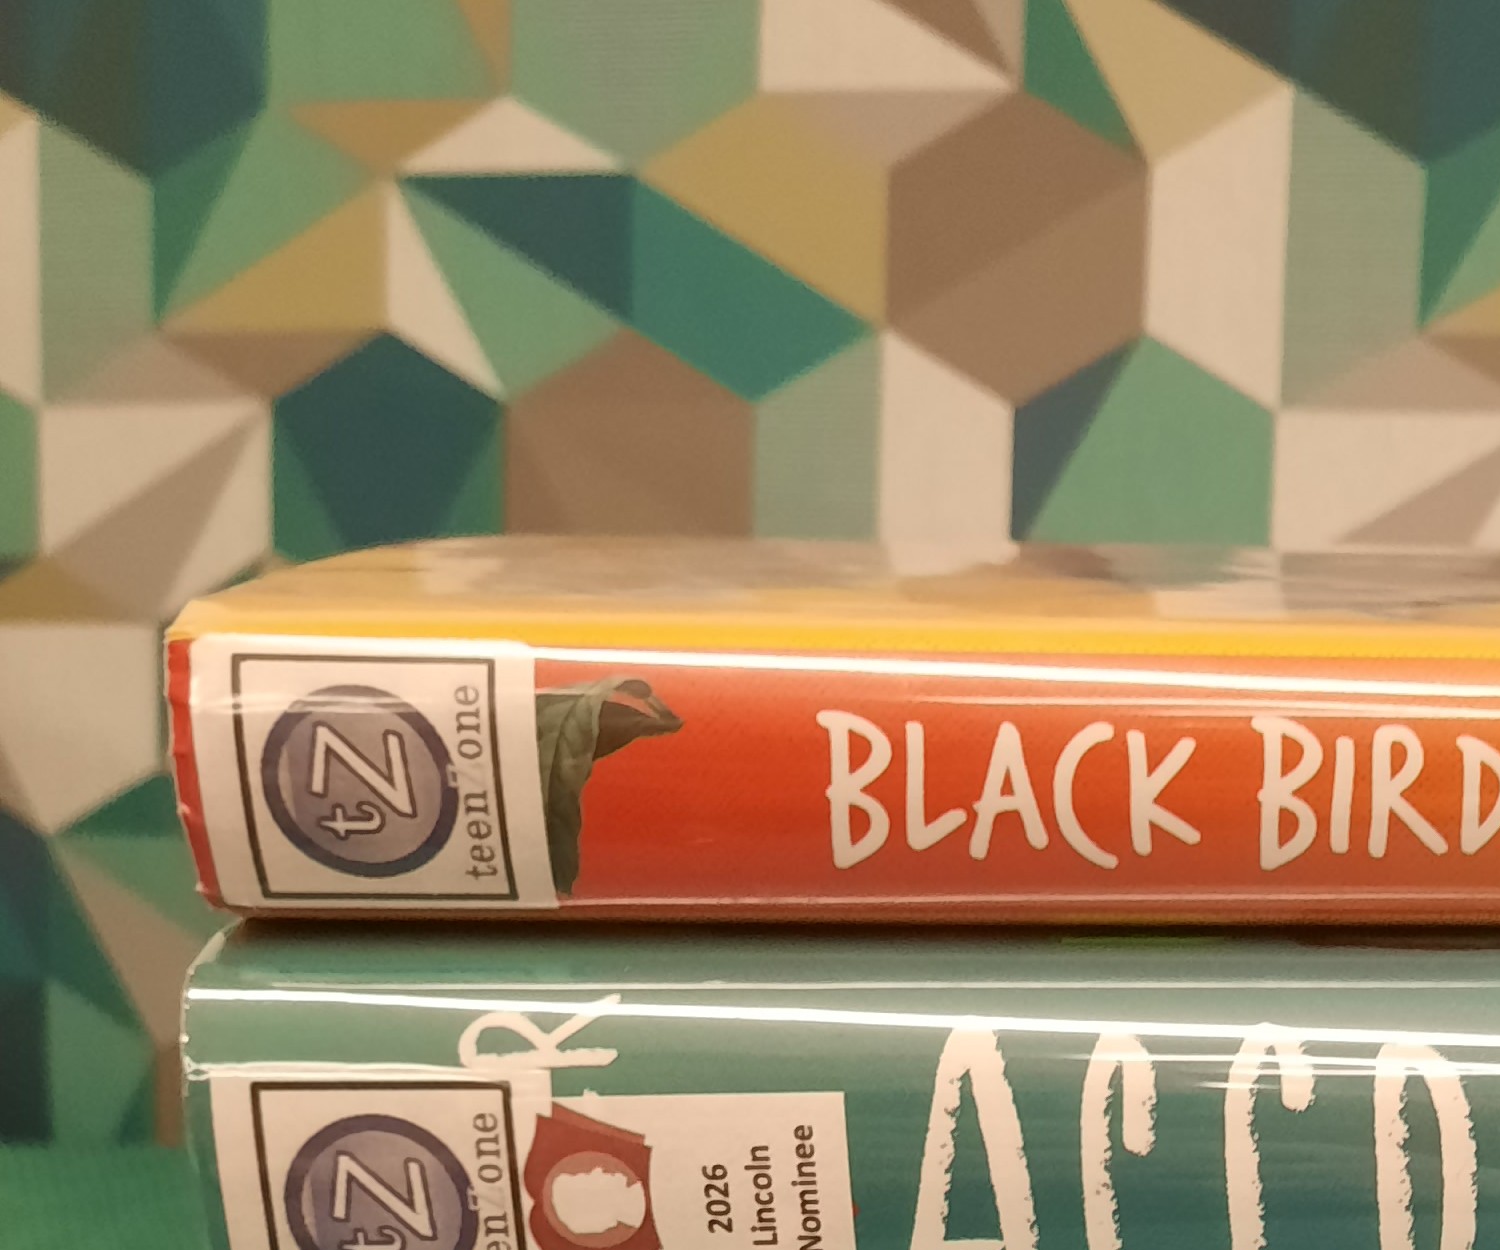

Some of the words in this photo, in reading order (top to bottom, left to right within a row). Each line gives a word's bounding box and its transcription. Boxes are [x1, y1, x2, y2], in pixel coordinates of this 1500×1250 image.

[816, 709, 1201, 870] BLACK
[701, 1163, 735, 1235] 2026
[752, 1144, 779, 1248] Lincoln
